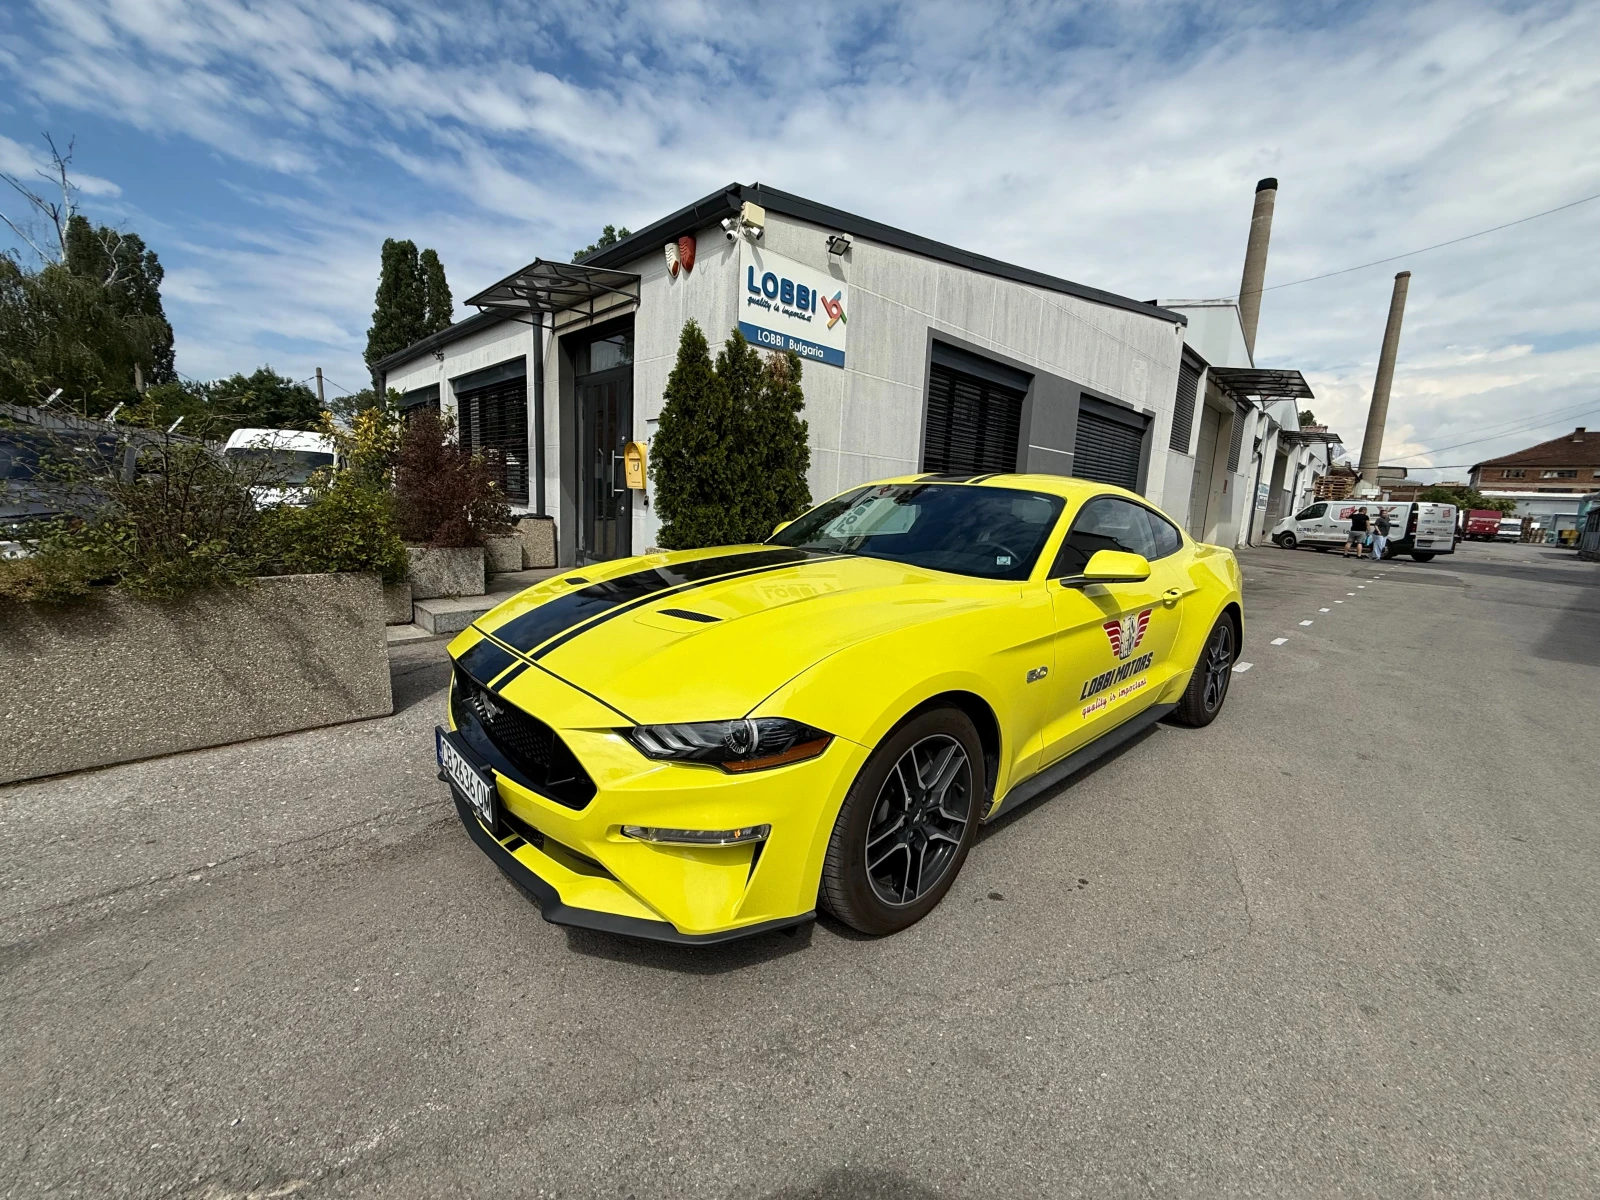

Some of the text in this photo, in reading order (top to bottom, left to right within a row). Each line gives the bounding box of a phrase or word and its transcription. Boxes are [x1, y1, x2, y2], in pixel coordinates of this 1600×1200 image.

[747, 265, 817, 314] LOBBI
[747, 296, 772, 313] quality
[773, 302, 780, 312] is
[757, 330, 824, 358] LOBBI Bulgaria
[1079, 652, 1154, 702] LOBBI MOTORS
[1082, 678, 1147, 719] quality is important
[441, 739, 453, 772] CB
[453, 754, 476, 799] 2636
